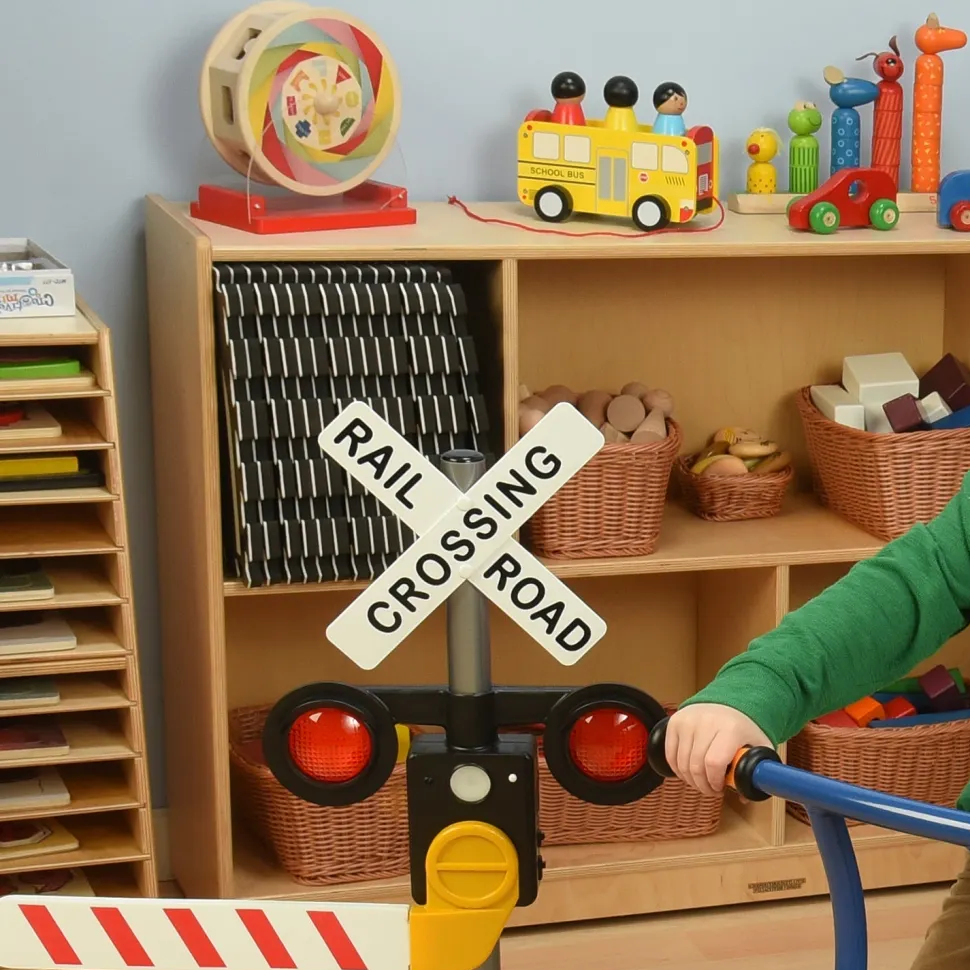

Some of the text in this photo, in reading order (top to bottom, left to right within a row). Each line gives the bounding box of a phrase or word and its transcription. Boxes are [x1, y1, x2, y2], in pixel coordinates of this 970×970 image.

[530, 166, 585, 179] SCHOOL BUS
[333, 417, 423, 510] RAIL
[366, 445, 562, 634] CROSSING
[483, 552, 592, 652] ROAD
